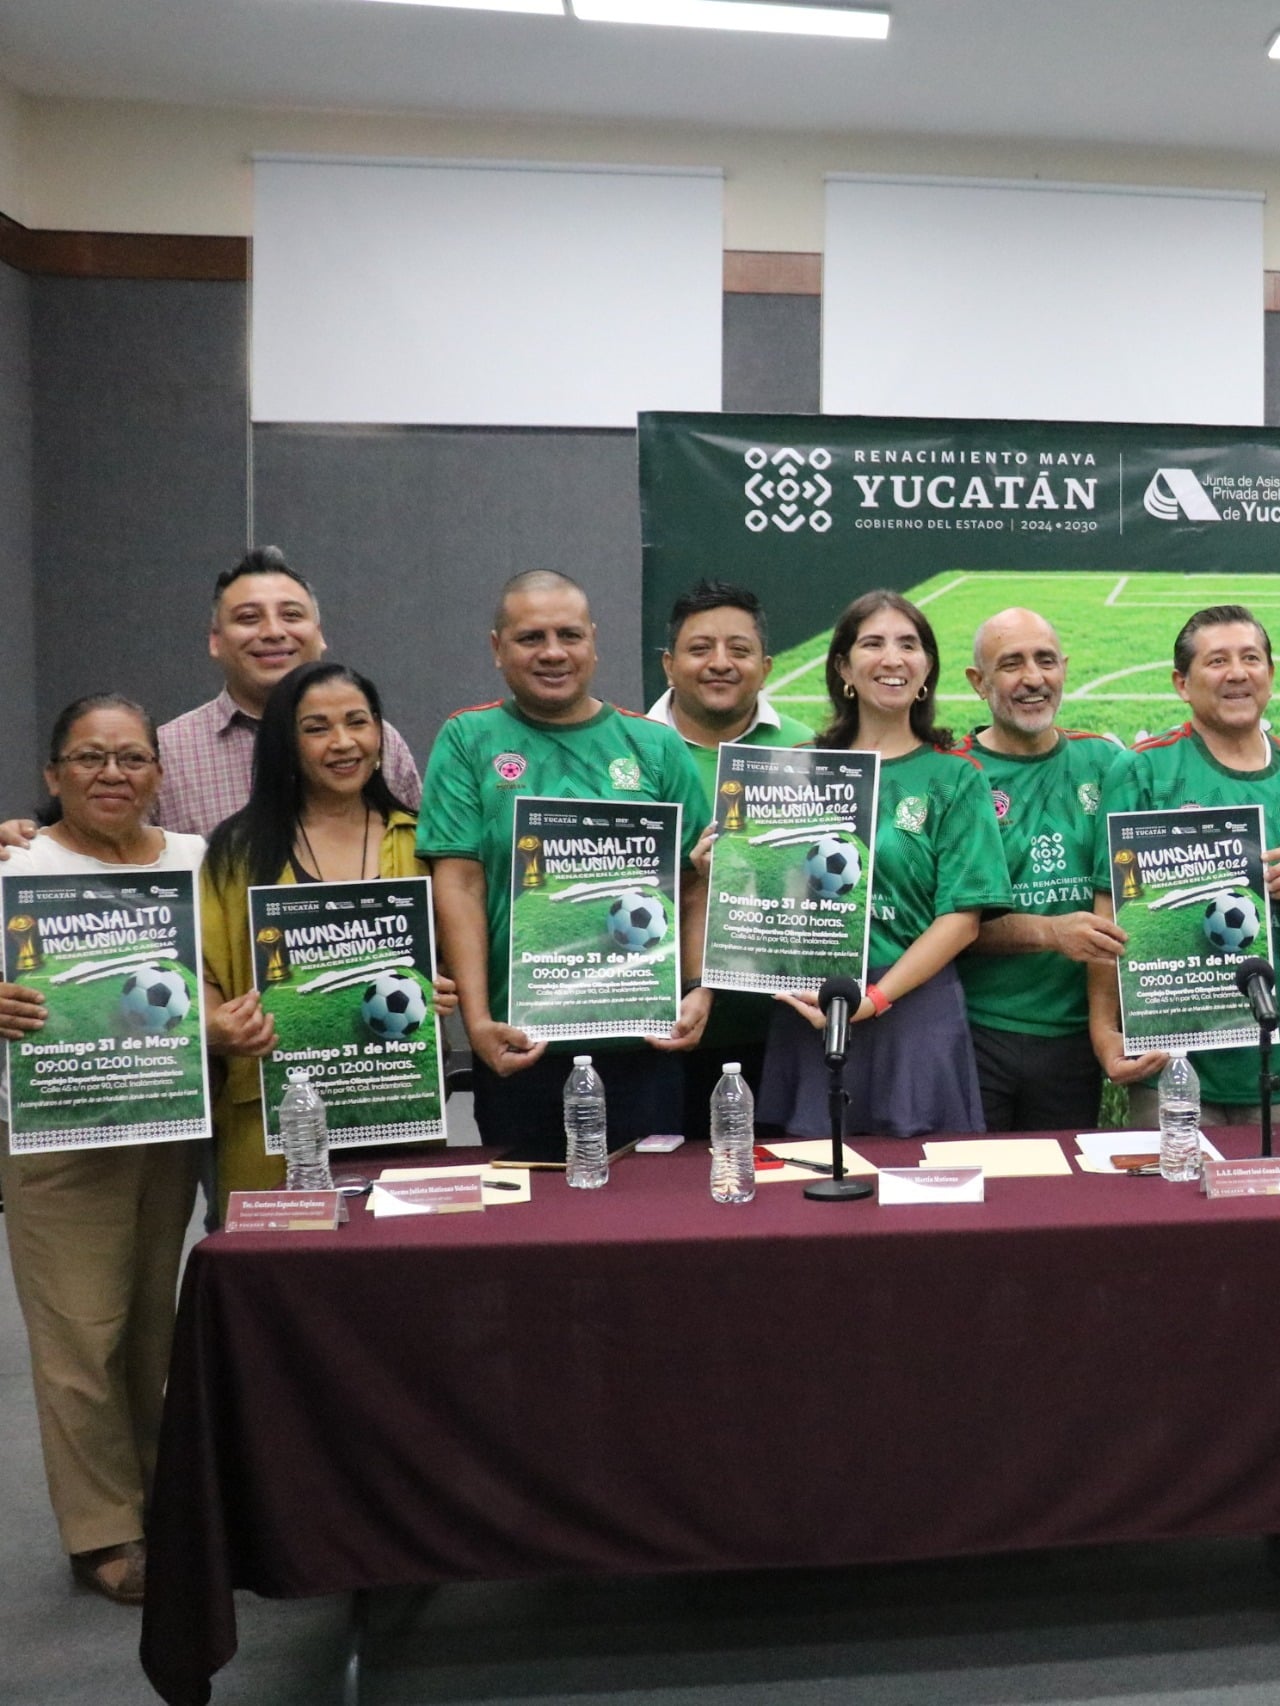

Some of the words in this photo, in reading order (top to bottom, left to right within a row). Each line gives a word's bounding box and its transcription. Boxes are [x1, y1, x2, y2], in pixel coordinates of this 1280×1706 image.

[854, 450, 1028, 464] RENACIMIENTO
[1039, 452, 1096, 465] MAYA
[1202, 475, 1234, 487] Junta
[1237, 476, 1252, 487] de
[853, 471, 1098, 510] YUCATÁN
[1213, 488, 1258, 500] Privada
[1263, 488, 1280, 501] del
[1222, 507, 1240, 521] de
[855, 519, 923, 529] GOBIERNO
[927, 519, 951, 529] DEL
[956, 519, 1004, 530] ESTADO
[824, 803, 857, 813] 2026
[626, 856, 659, 867] 2026
[1217, 857, 1247, 870] 2026
[719, 893, 778, 910] Domingo
[781, 896, 794, 908] 31
[799, 898, 817, 910] de
[819, 899, 857, 914] Mayo
[728, 910, 763, 923] 09:00
[776, 913, 807, 925] 12:00
[138, 926, 176, 940] 2026
[377, 934, 413, 949] 2026
[521, 951, 584, 966] Domingo
[587, 952, 601, 963] 31
[606, 952, 624, 963] de
[1128, 958, 1185, 971] Domingo
[1187, 955, 1200, 967] 31
[1205, 954, 1222, 966] de
[532, 967, 569, 978] 09:00
[1139, 974, 1173, 986] 09:00
[1184, 971, 1214, 983] 12:00
[21, 1040, 95, 1055] Domingo
[98, 1038, 114, 1051] 31
[121, 1037, 142, 1049] de
[145, 1035, 189, 1049] Mayo
[272, 1047, 340, 1061] Domingo
[342, 1043, 357, 1056] 31
[363, 1042, 383, 1055] de
[385, 1040, 426, 1053] Mayo
[35, 1058, 78, 1073] 09:00
[94, 1055, 132, 1069] 12:00
[134, 1055, 177, 1066] horas.
[339, 1060, 373, 1073] 12:00
[375, 1059, 415, 1070] horas.
